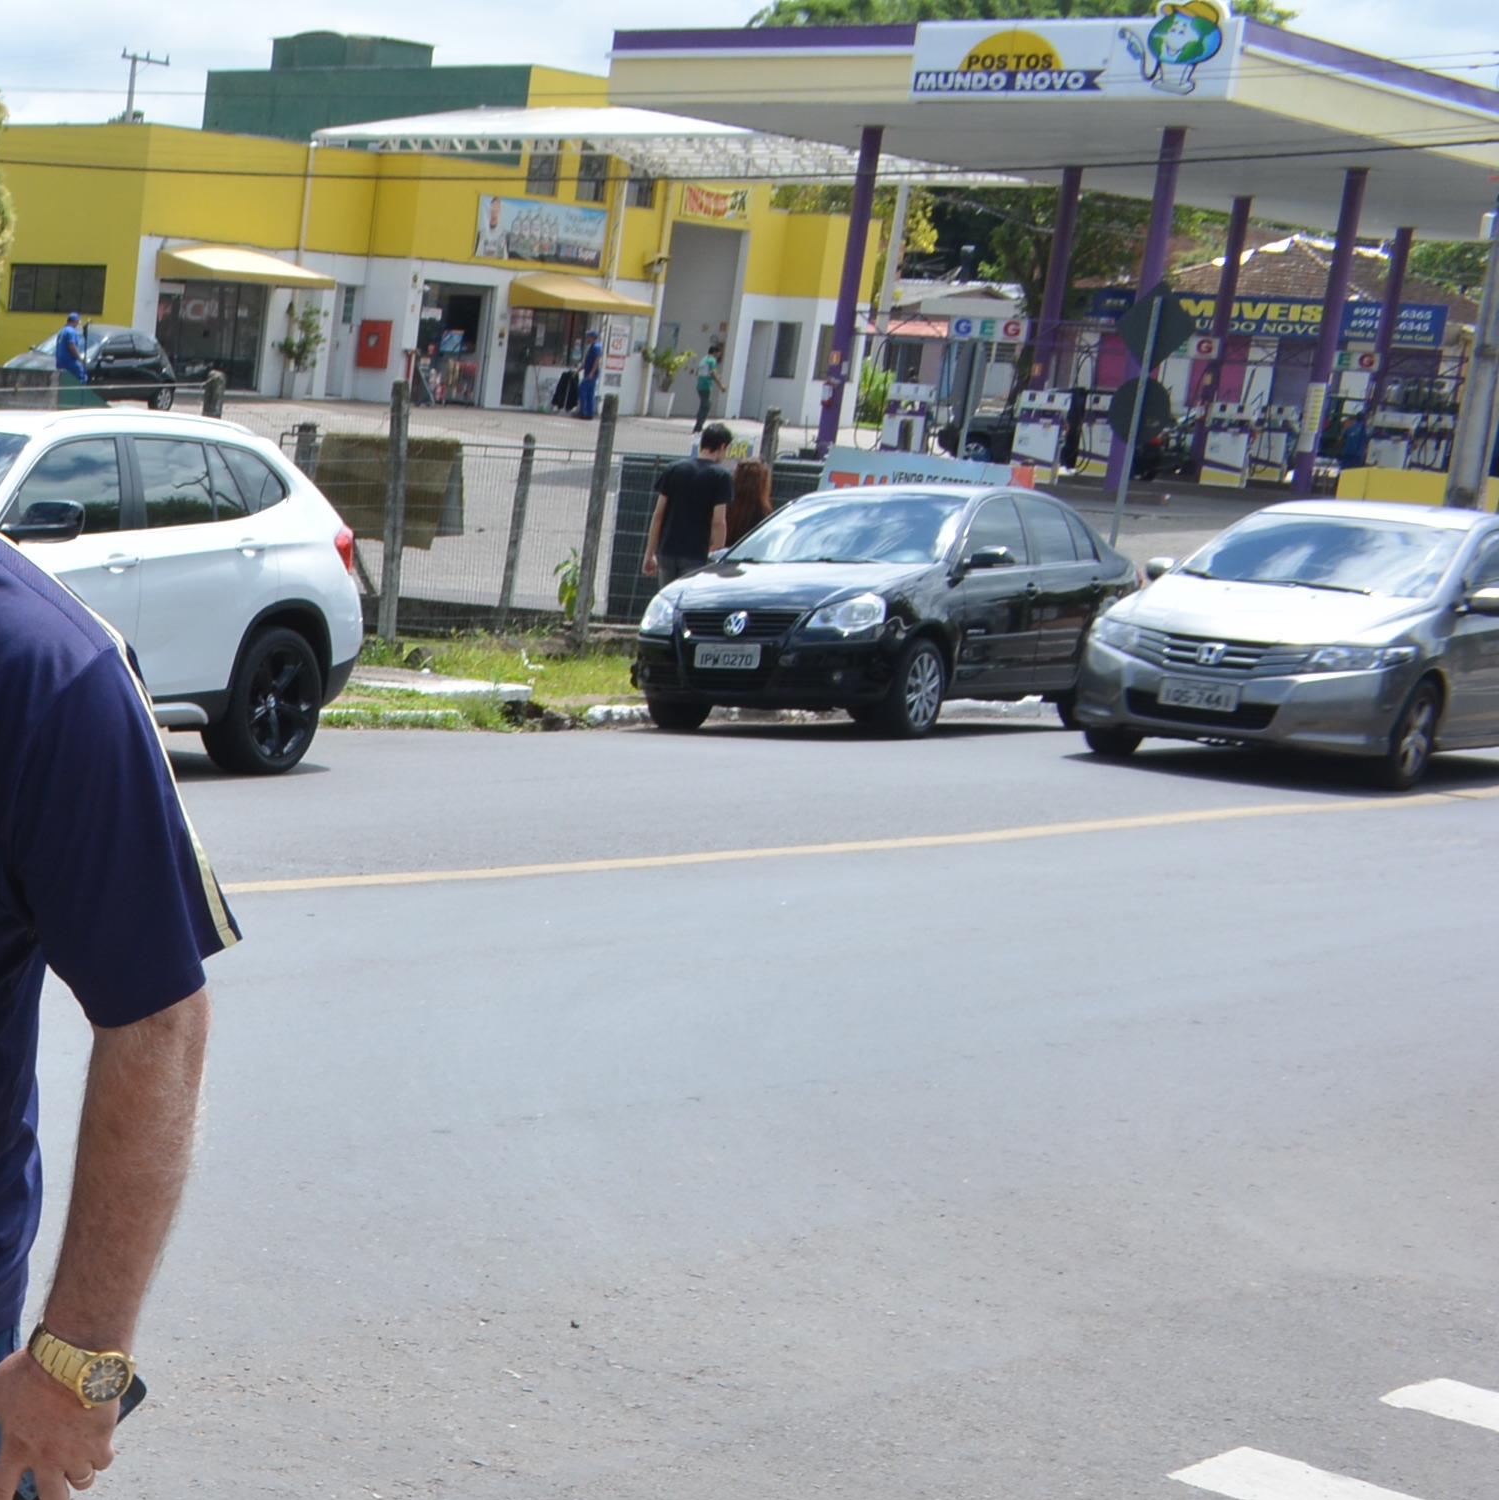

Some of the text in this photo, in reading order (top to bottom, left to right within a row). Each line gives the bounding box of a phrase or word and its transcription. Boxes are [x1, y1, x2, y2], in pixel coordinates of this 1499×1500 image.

[967, 54, 1053, 69] POSTOS
[916, 72, 1086, 91] MUNDO NOVO
